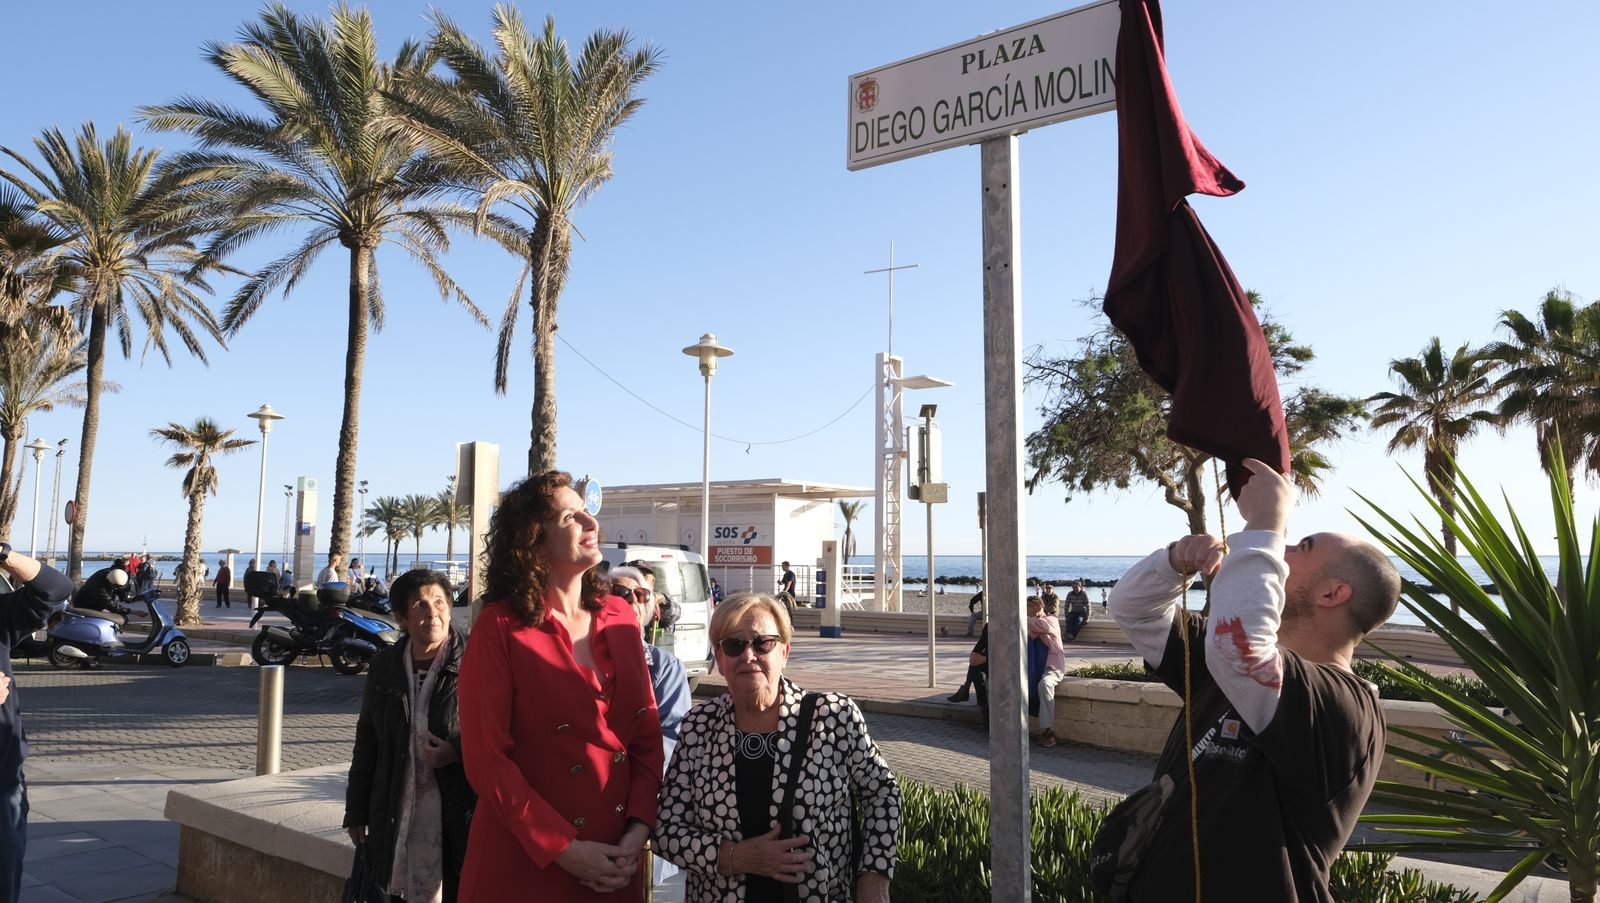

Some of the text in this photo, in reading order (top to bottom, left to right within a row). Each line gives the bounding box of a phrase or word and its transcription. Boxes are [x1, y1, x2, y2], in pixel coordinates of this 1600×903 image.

[960, 33, 1045, 75] PLAZA
[855, 106, 926, 153] DIEGO
[932, 73, 1028, 134] GARCÍA
[715, 527, 738, 539] SOS
[717, 547, 753, 555] PUESTO DE
[715, 555, 758, 563] SOCORRISMO
